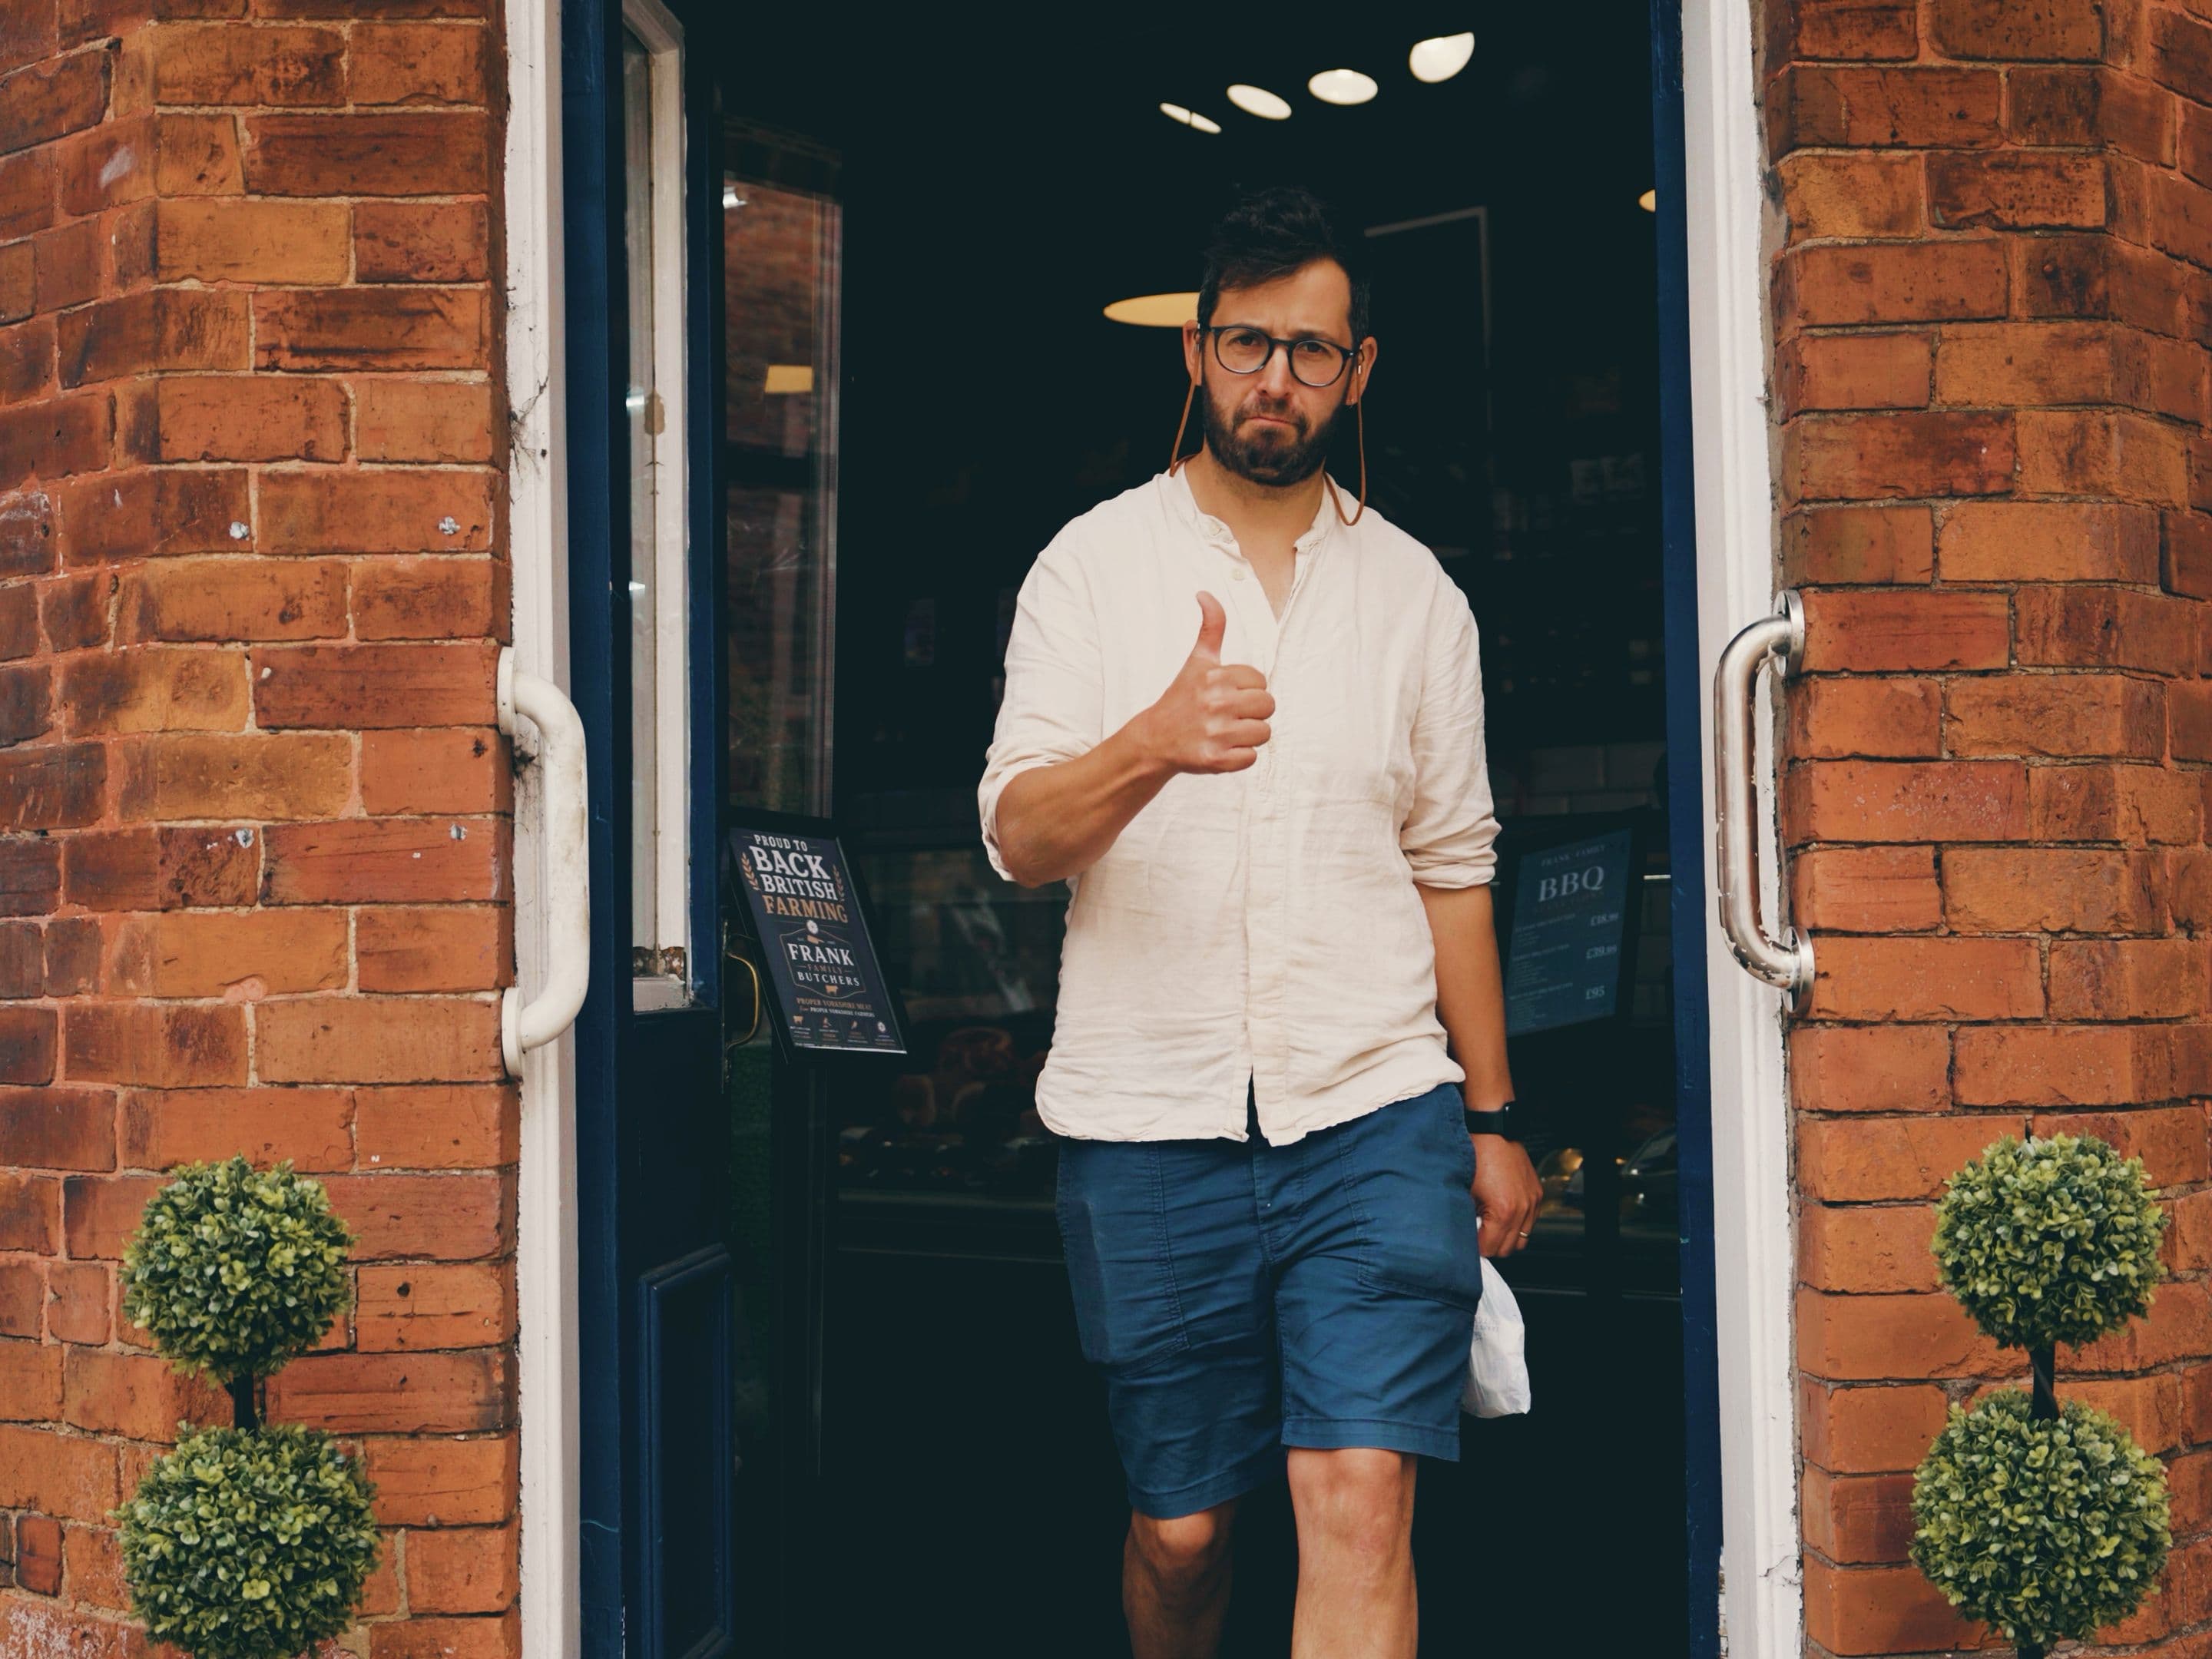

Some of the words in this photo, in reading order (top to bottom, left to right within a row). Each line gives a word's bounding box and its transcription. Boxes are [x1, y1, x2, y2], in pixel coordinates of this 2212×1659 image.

[753, 834, 790, 849] PROUD
[794, 840, 808, 852] TO
[749, 846, 831, 880] BACK
[760, 874, 838, 901] BRITISH
[1538, 866, 1605, 902] BBQ
[762, 894, 848, 923] FARMING
[787, 943, 854, 966] FRANK
[796, 971, 860, 986] BUTCHERS
[806, 964, 843, 974] FAMILY
[1584, 985, 1605, 1001] £95
